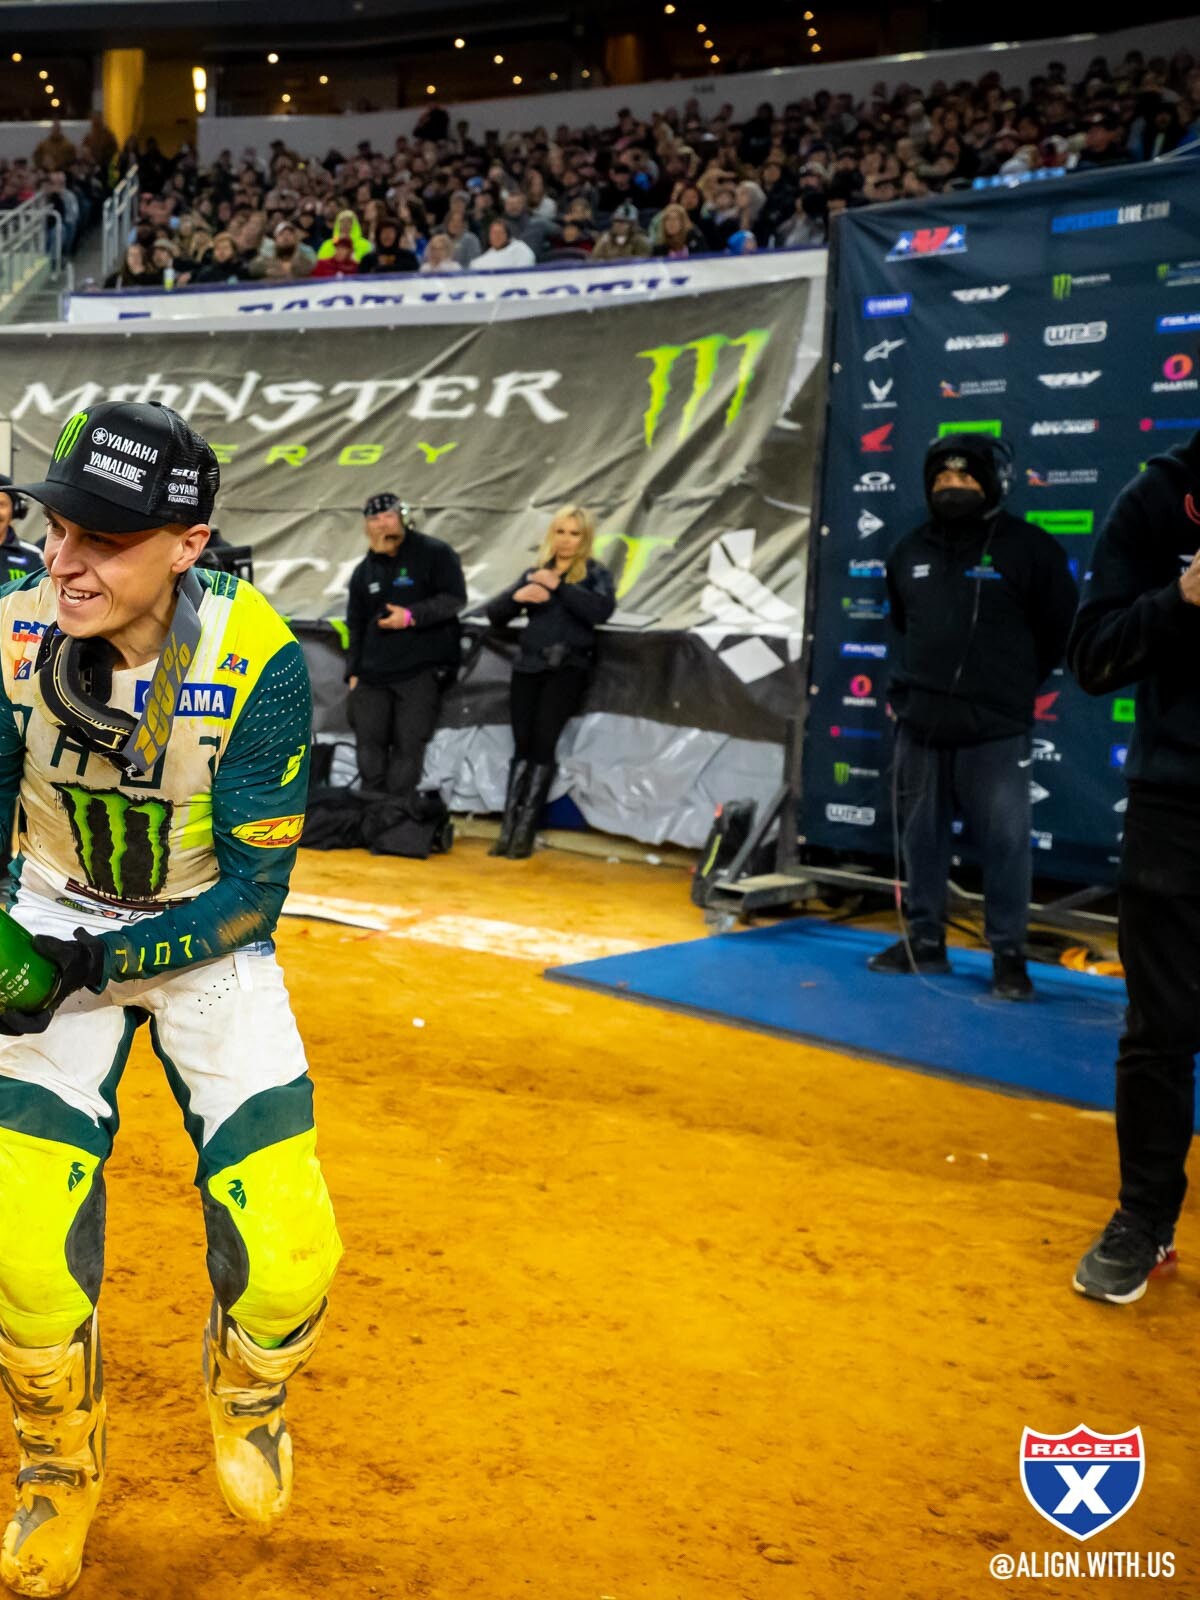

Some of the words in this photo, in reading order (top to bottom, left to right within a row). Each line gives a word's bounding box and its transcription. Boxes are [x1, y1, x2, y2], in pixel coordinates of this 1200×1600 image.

[107, 434, 159, 465] YAMAHA
[89, 451, 143, 483] YAMALUBE
[134, 632, 191, 766] 100%
[6, 962, 30, 990] Class
